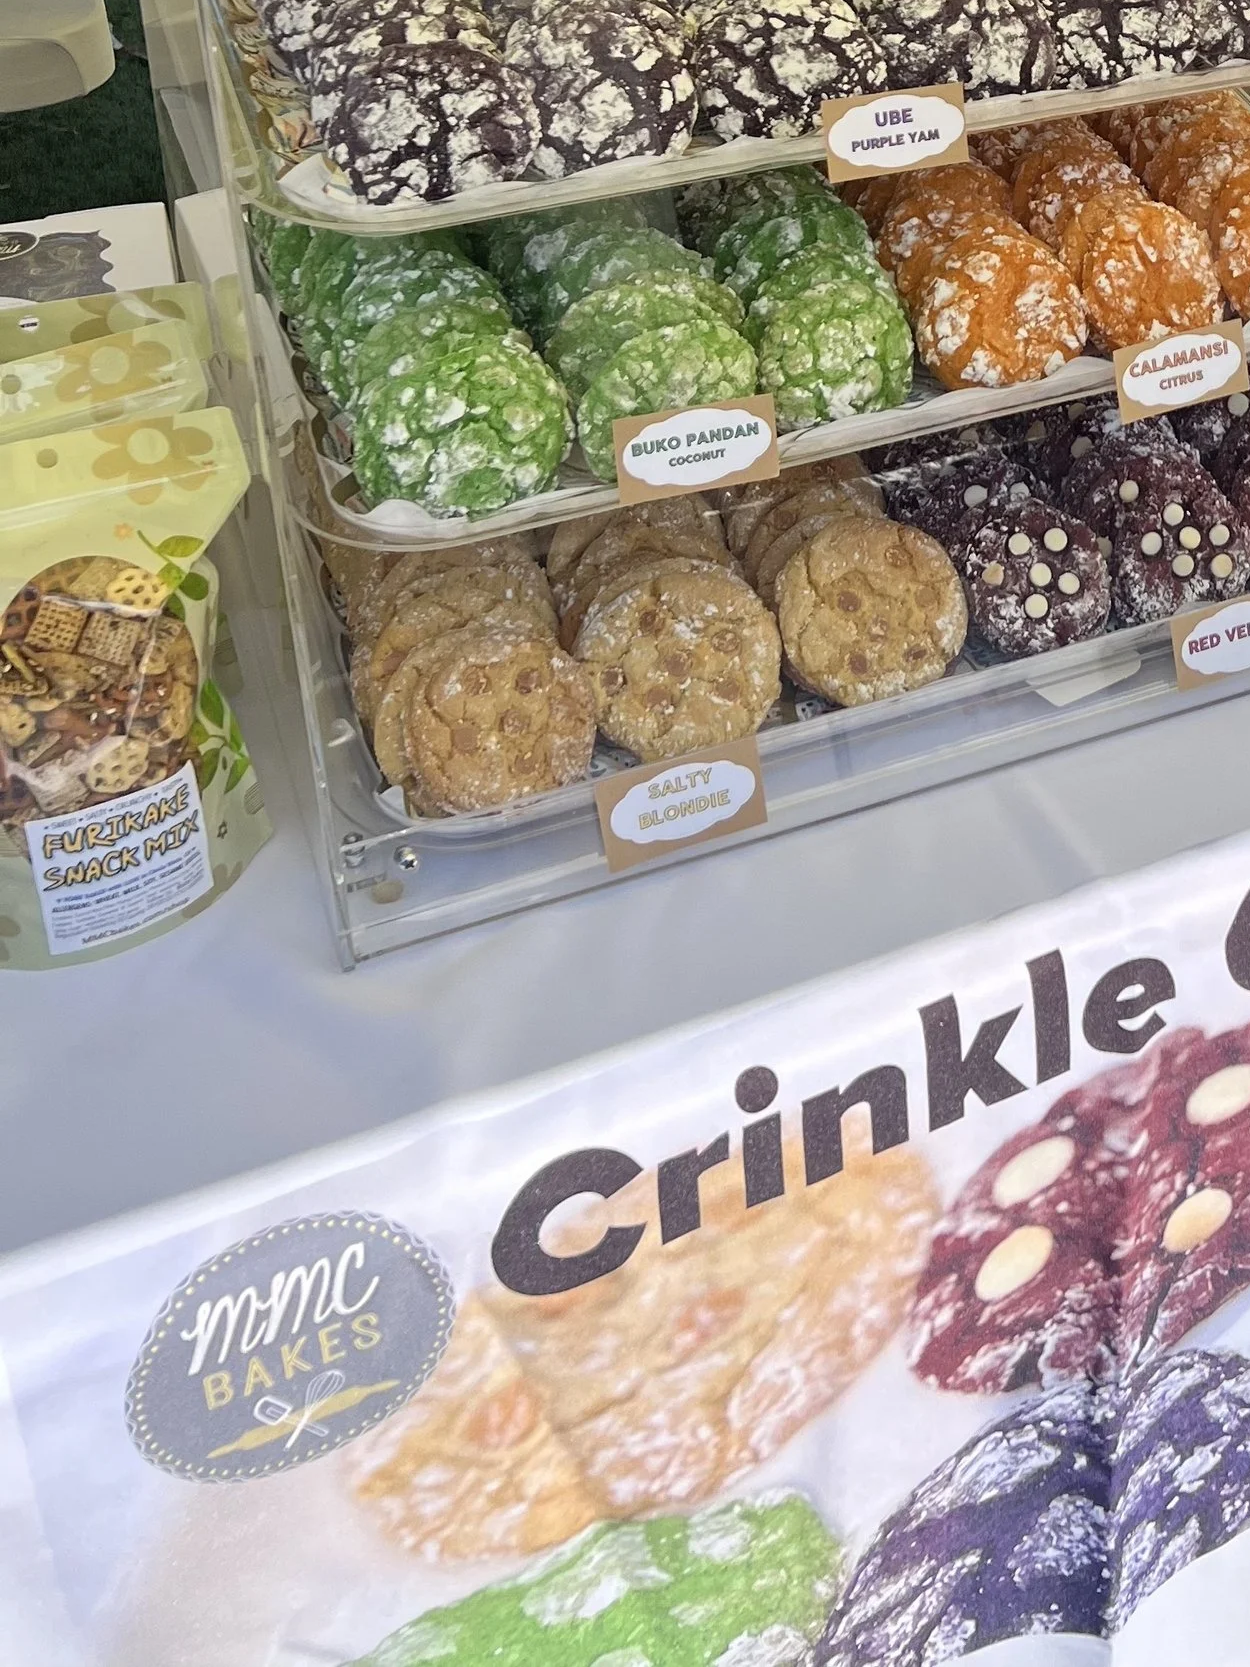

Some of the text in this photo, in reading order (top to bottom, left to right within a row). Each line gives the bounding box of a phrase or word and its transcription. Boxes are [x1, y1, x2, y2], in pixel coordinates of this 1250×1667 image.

[874, 107, 914, 127] UBE
[851, 128, 940, 153] PURPLE YAM
[1129, 340, 1229, 378] CALAMANSI
[1159, 369, 1204, 390] CITRUS
[631, 421, 760, 457] BUKO PANDAN
[668, 448, 726, 467] COCONUT
[1188, 633, 1221, 655] RED
[648, 767, 713, 799] SALTY
[43, 783, 189, 859] FURIKAKE
[638, 788, 731, 830] BLONDIE
[43, 846, 140, 892] SNACK
[143, 809, 200, 861] MIX
[490, 946, 1177, 1297] Crinkle
[202, 1312, 381, 1411] BAKES
